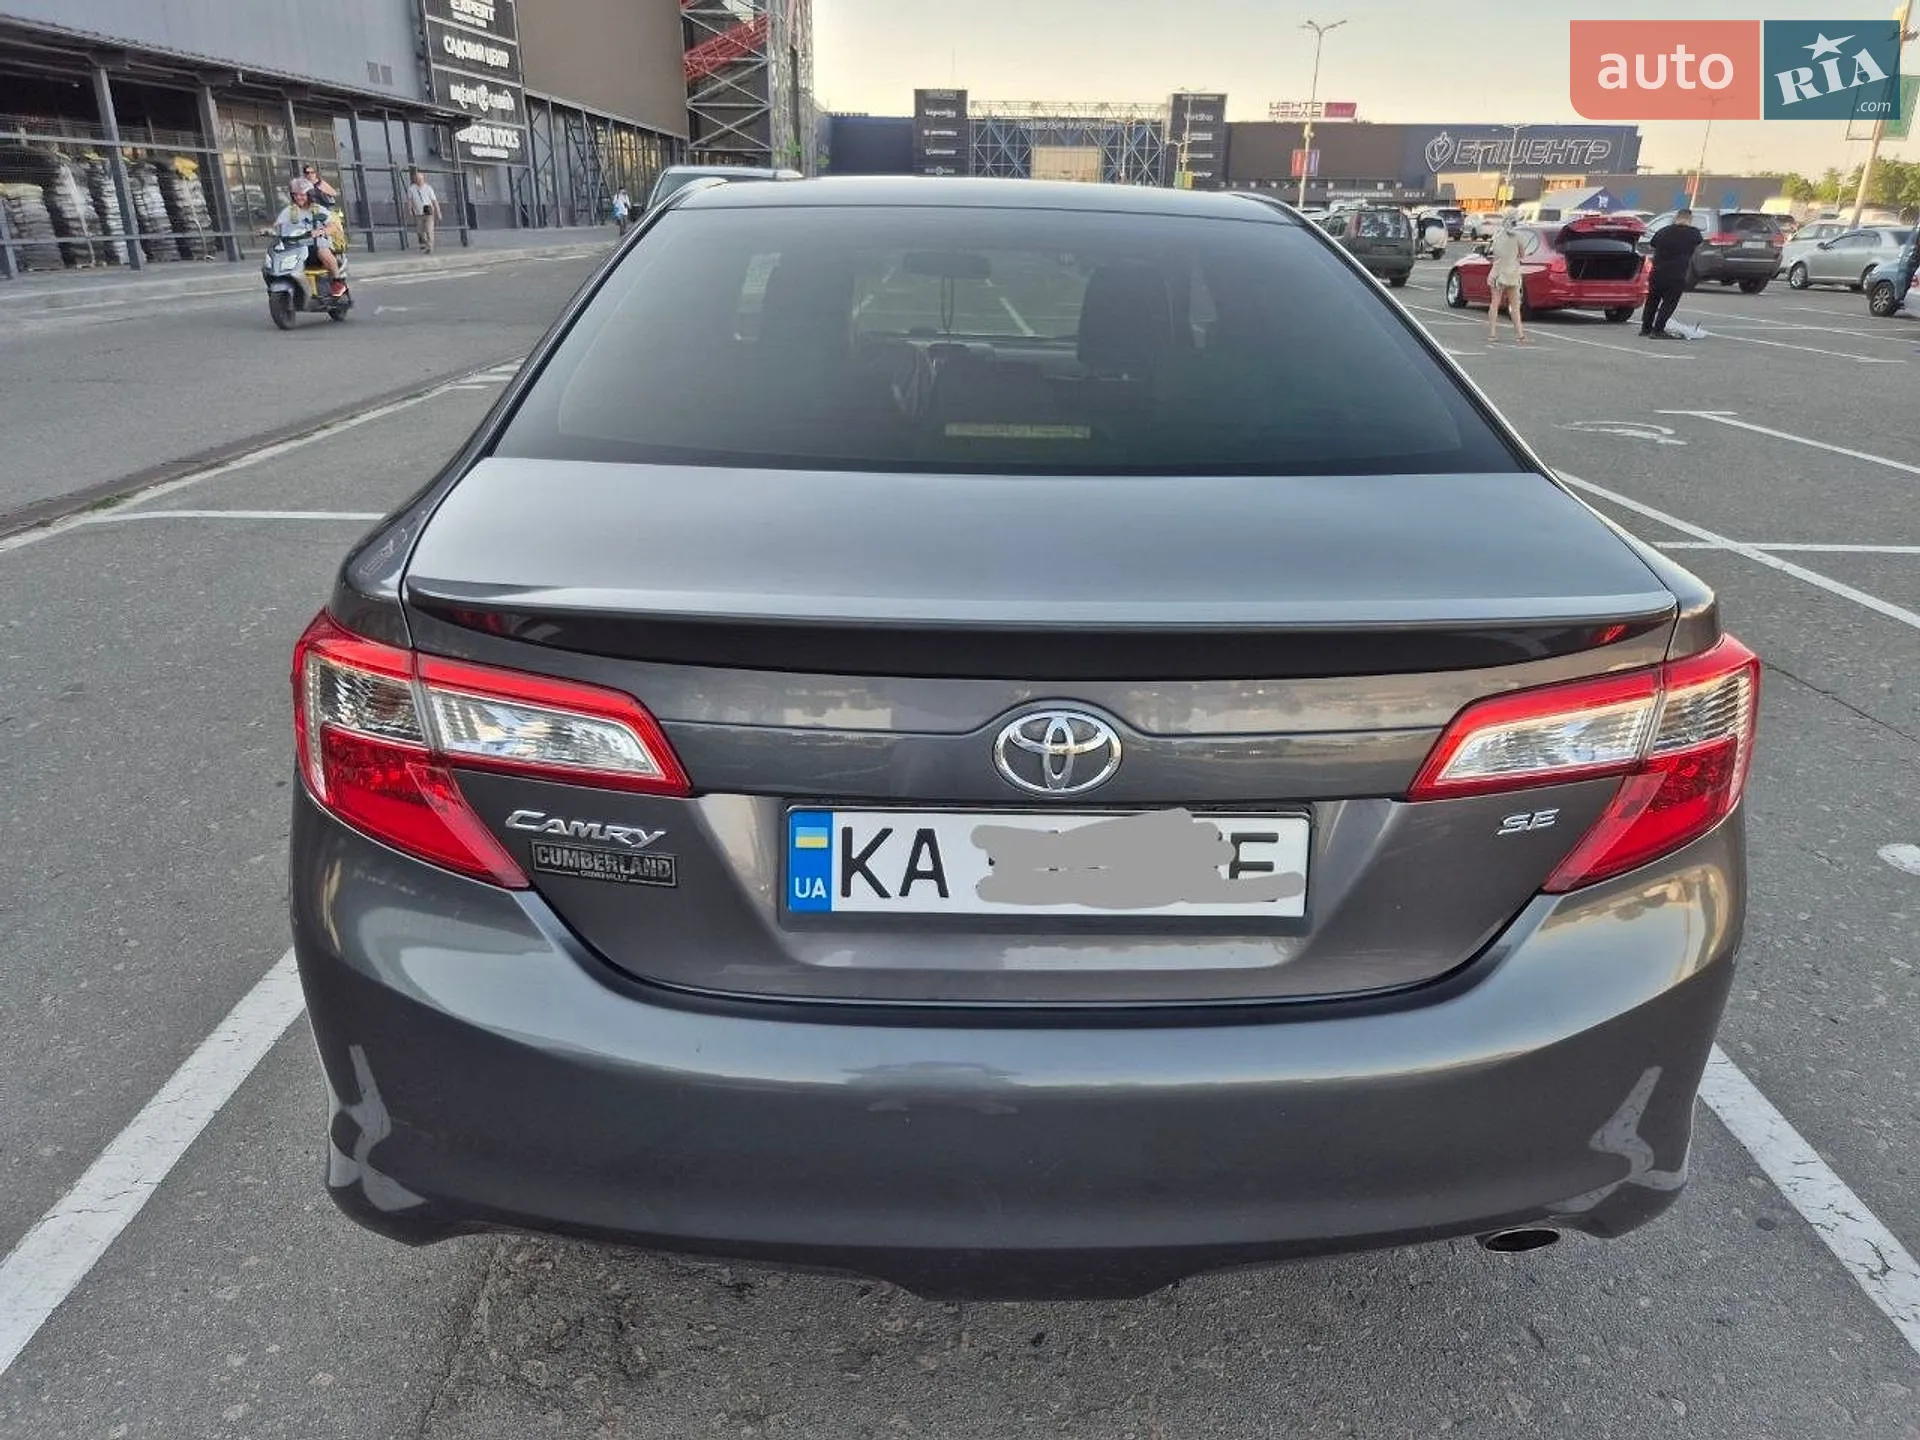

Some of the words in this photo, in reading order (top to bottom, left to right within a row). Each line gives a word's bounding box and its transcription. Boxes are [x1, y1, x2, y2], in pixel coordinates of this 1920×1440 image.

[505, 809, 667, 848] CAMRY
[1496, 809, 1560, 835] SE
[536, 845, 672, 878] CUMBERLAND
[840, 826, 950, 899] KA
[794, 877, 827, 899] UA
